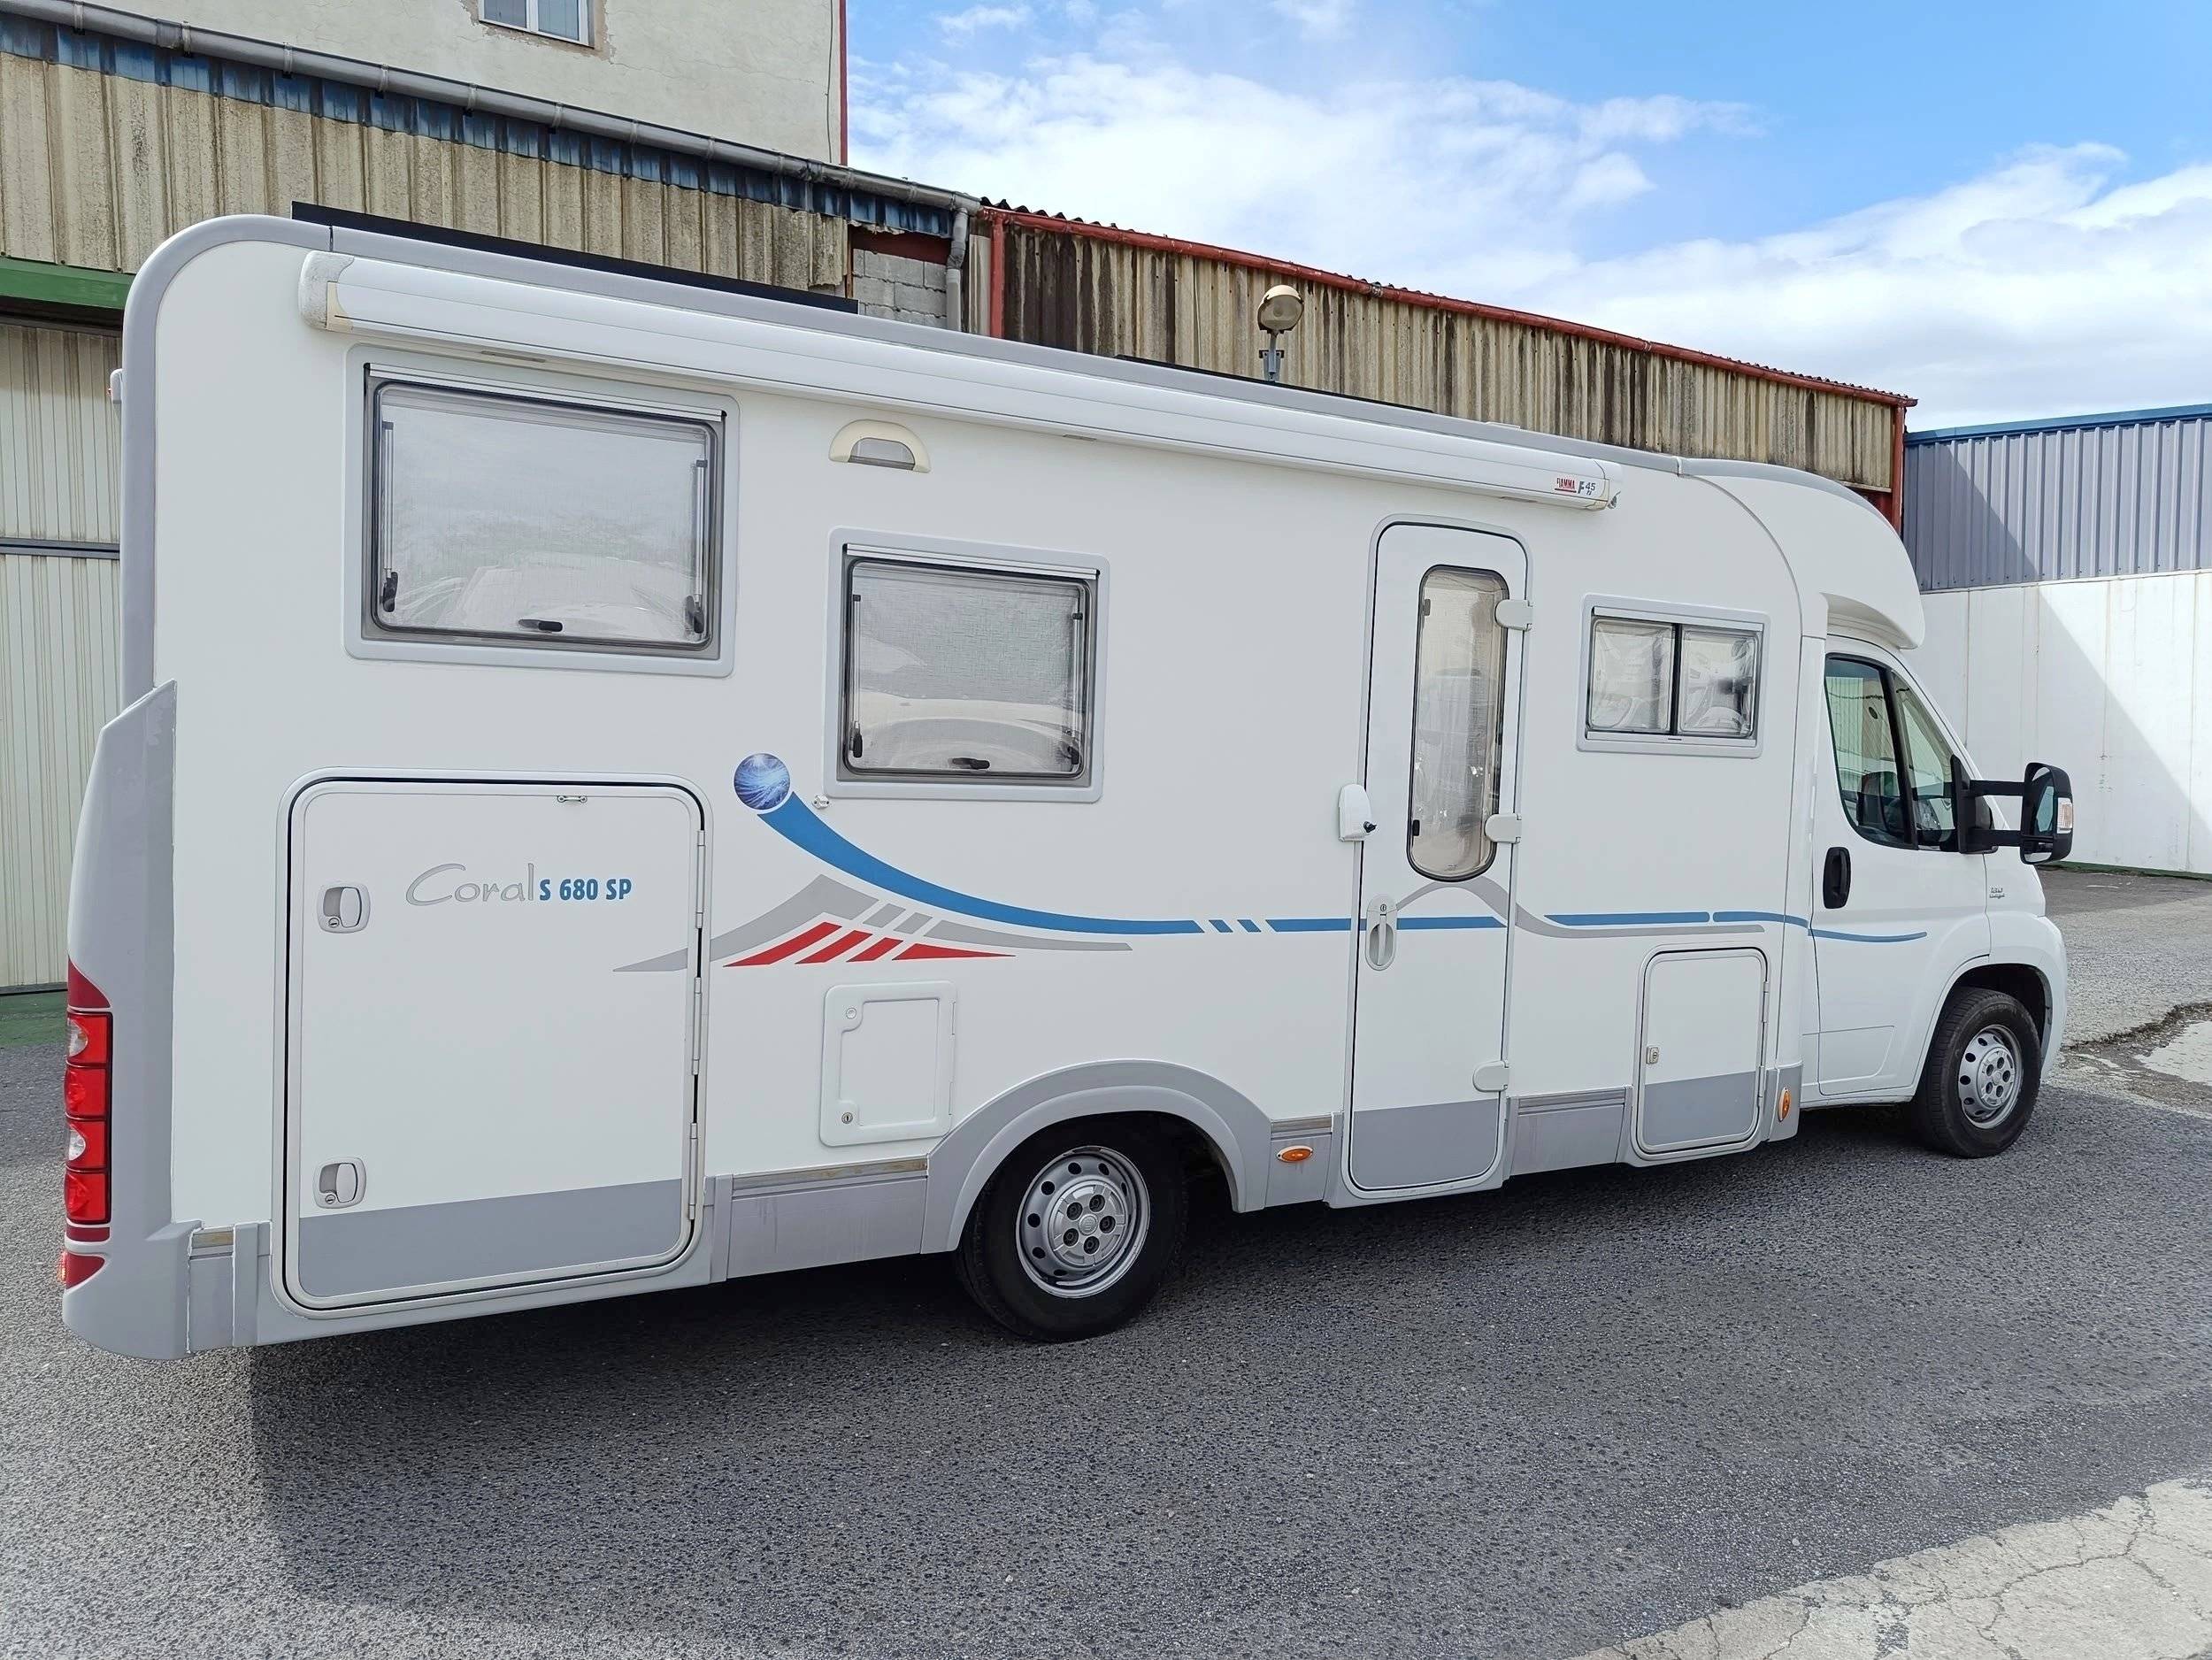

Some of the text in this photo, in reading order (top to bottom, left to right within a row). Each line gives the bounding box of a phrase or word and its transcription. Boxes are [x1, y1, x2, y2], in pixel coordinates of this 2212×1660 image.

[405, 863, 632, 906] Coral S 680 SP
